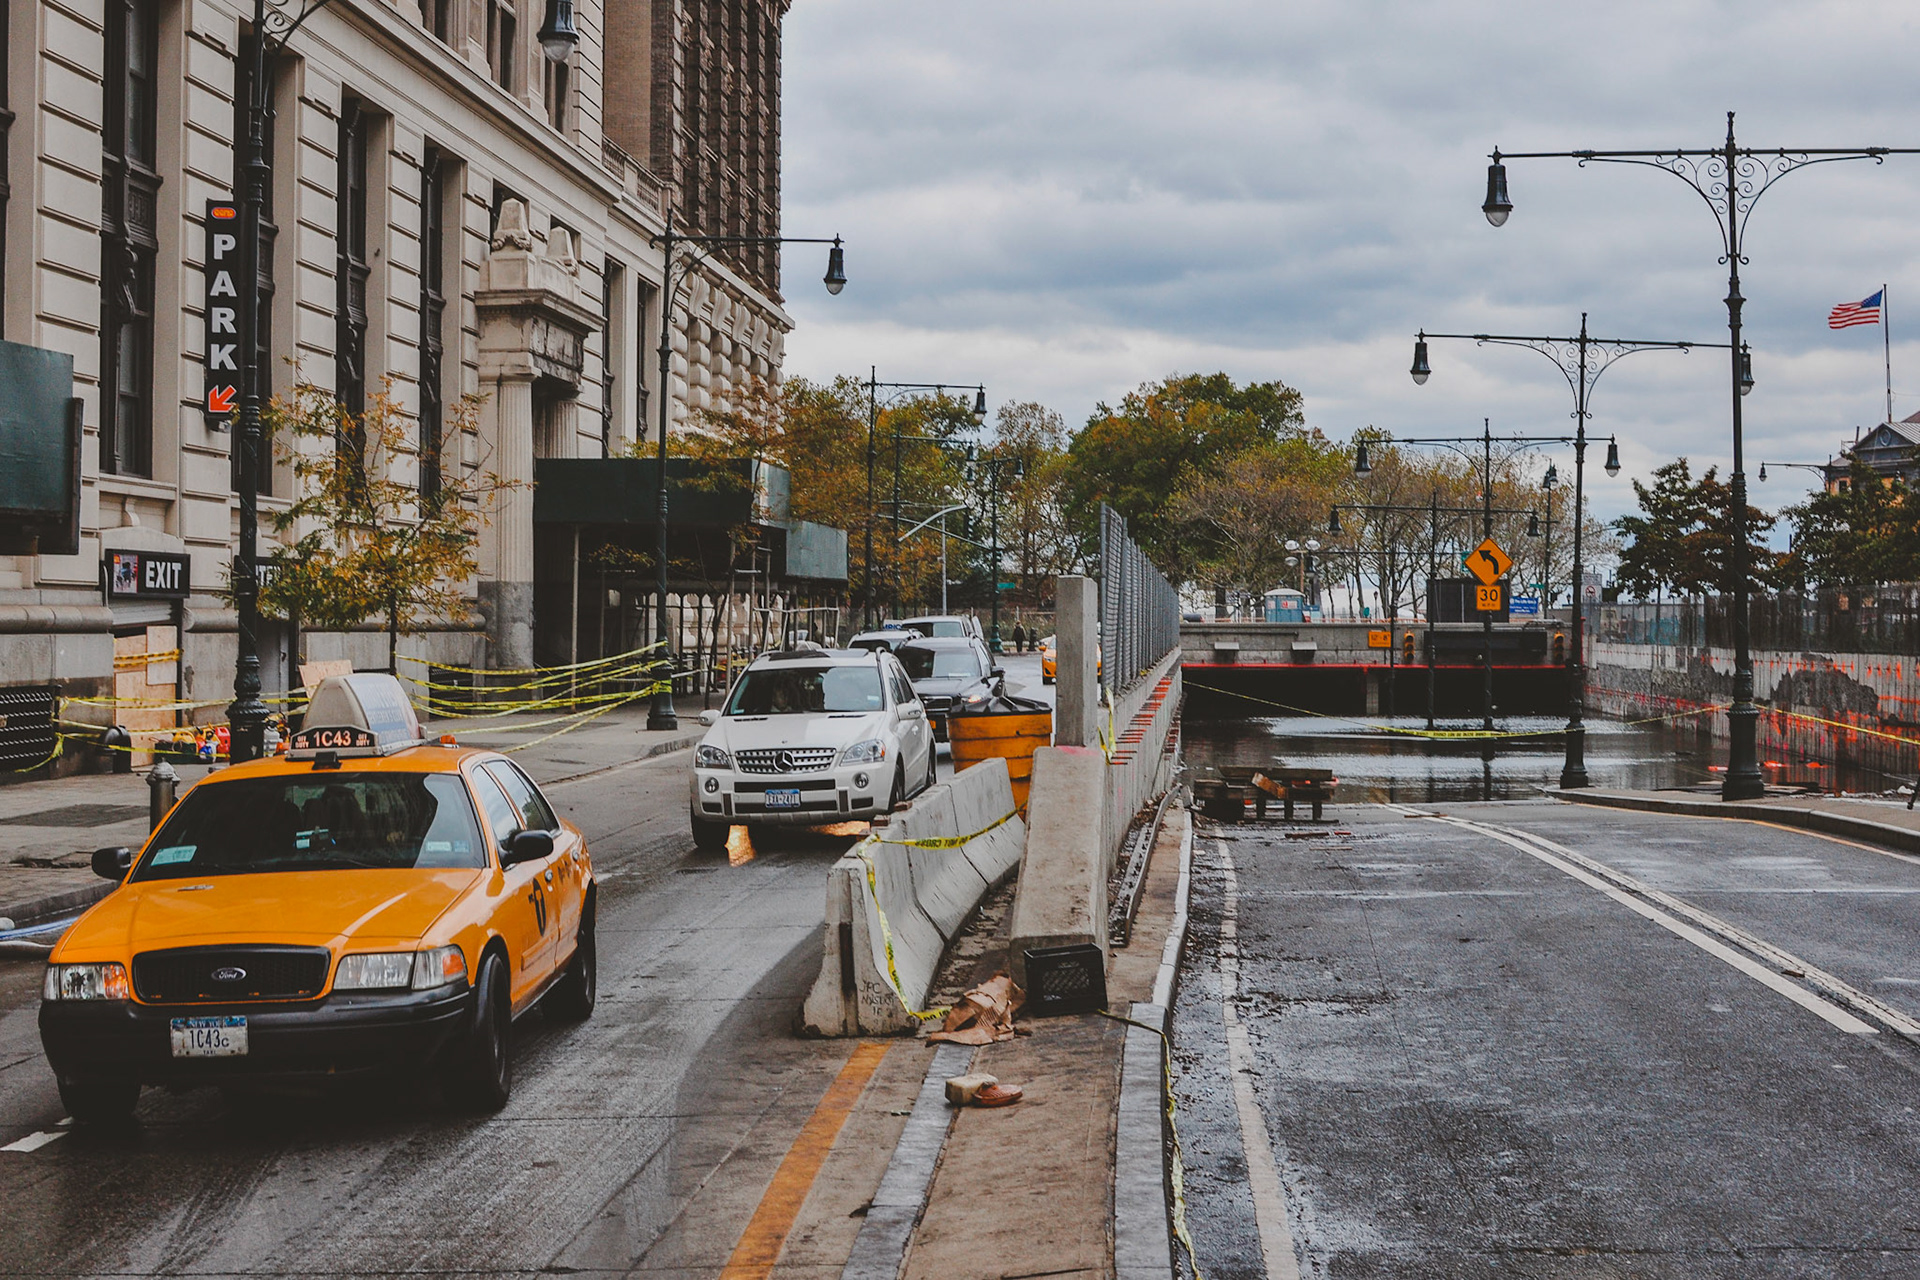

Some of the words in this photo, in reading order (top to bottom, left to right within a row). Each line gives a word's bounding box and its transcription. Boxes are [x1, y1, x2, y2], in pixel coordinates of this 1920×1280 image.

[209, 233, 238, 370] PARK
[145, 560, 182, 589] EXIT
[1480, 588, 1499, 602] 30
[313, 730, 352, 747] 1C43
[219, 970, 238, 979] Ford
